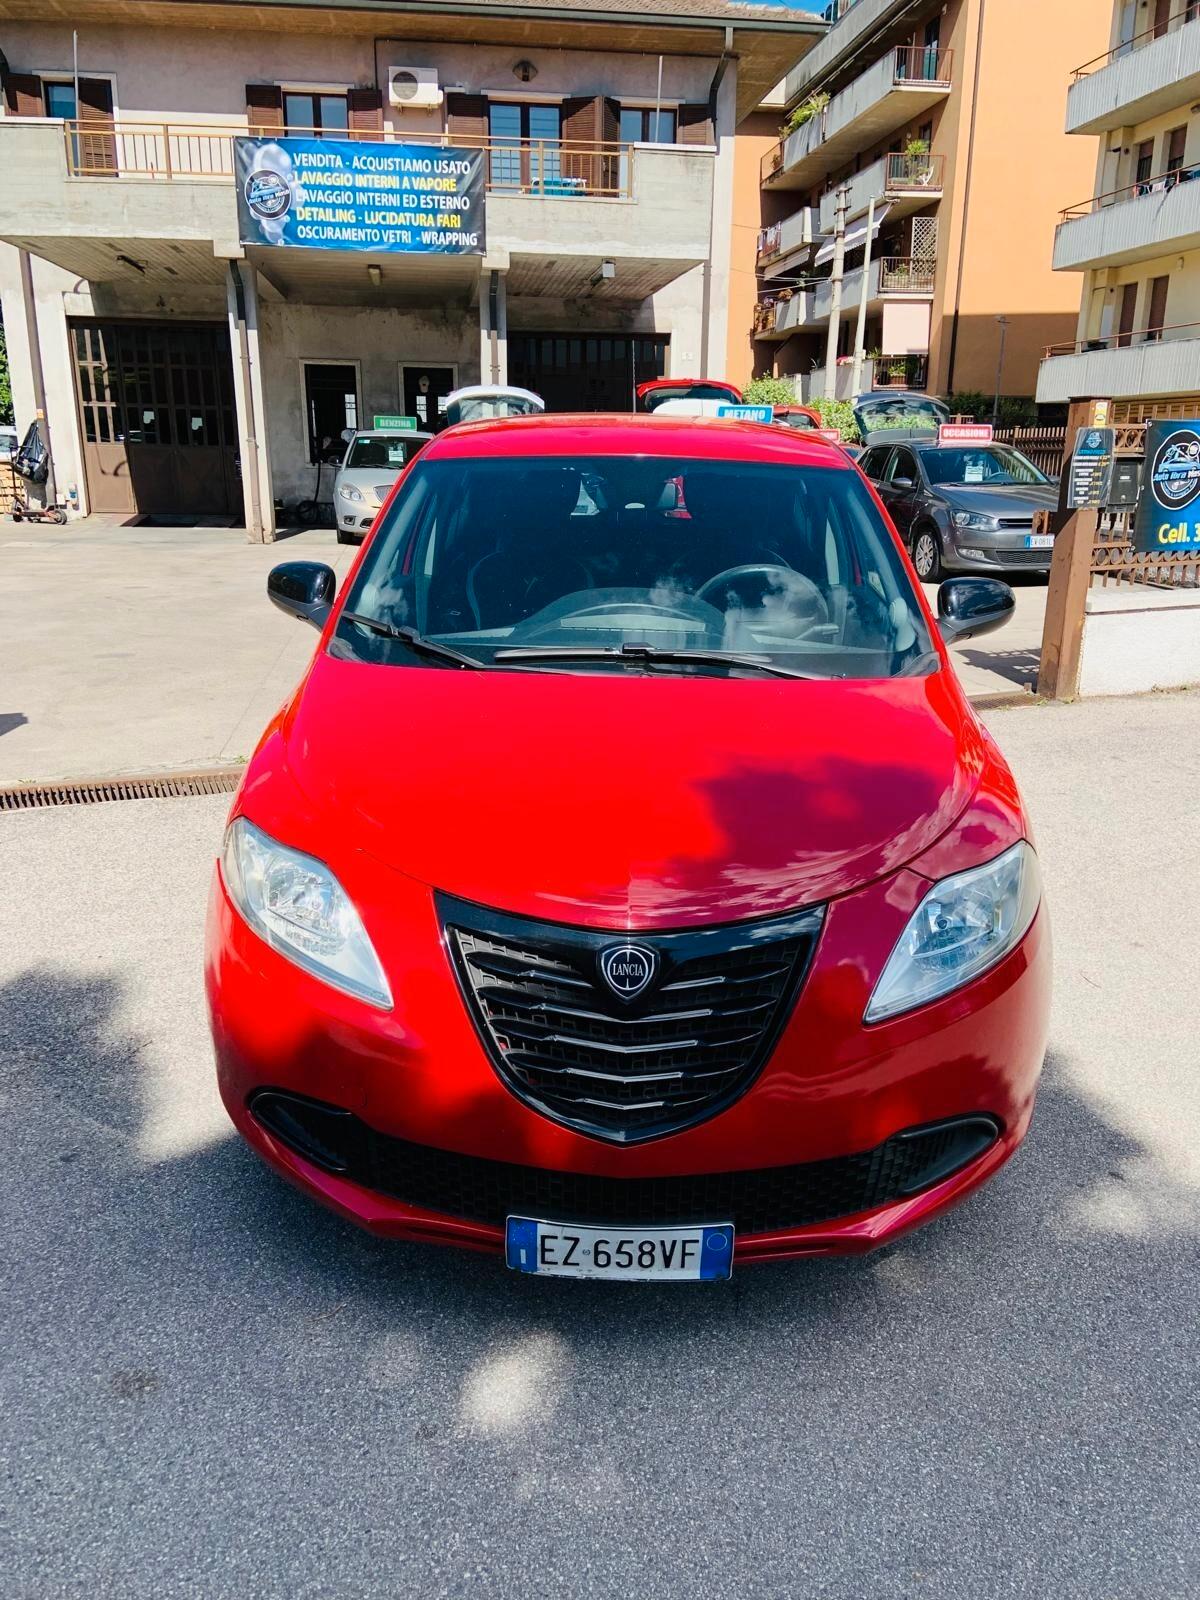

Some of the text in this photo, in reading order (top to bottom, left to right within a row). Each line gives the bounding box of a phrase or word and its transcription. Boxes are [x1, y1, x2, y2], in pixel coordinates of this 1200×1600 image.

[293, 153, 343, 168] VENDITA
[352, 156, 432, 173] ACQUISTIAMO
[434, 160, 471, 174] USATO
[294, 171, 457, 192] LAVAGGIO INTERNI A VAPORE
[295, 190, 470, 210] LAVAGGIO INTERNI ED ESTERNO
[296, 208, 356, 223] DETAILING
[364, 210, 435, 227] LUCIDATURA
[436, 214, 461, 228] FARI
[297, 226, 380, 242] OSCURAMENTO
[382, 229, 411, 244] VETRI
[420, 231, 478, 246] WRAPPING
[380, 419, 411, 428] BENZINA
[724, 409, 766, 420] METANO
[943, 428, 989, 438] OCCASIONE
[1158, 522, 1191, 544] Cell.
[612, 963, 644, 976] LANCIA
[540, 1234, 580, 1267] EZ
[593, 1239, 700, 1269] 658VF
